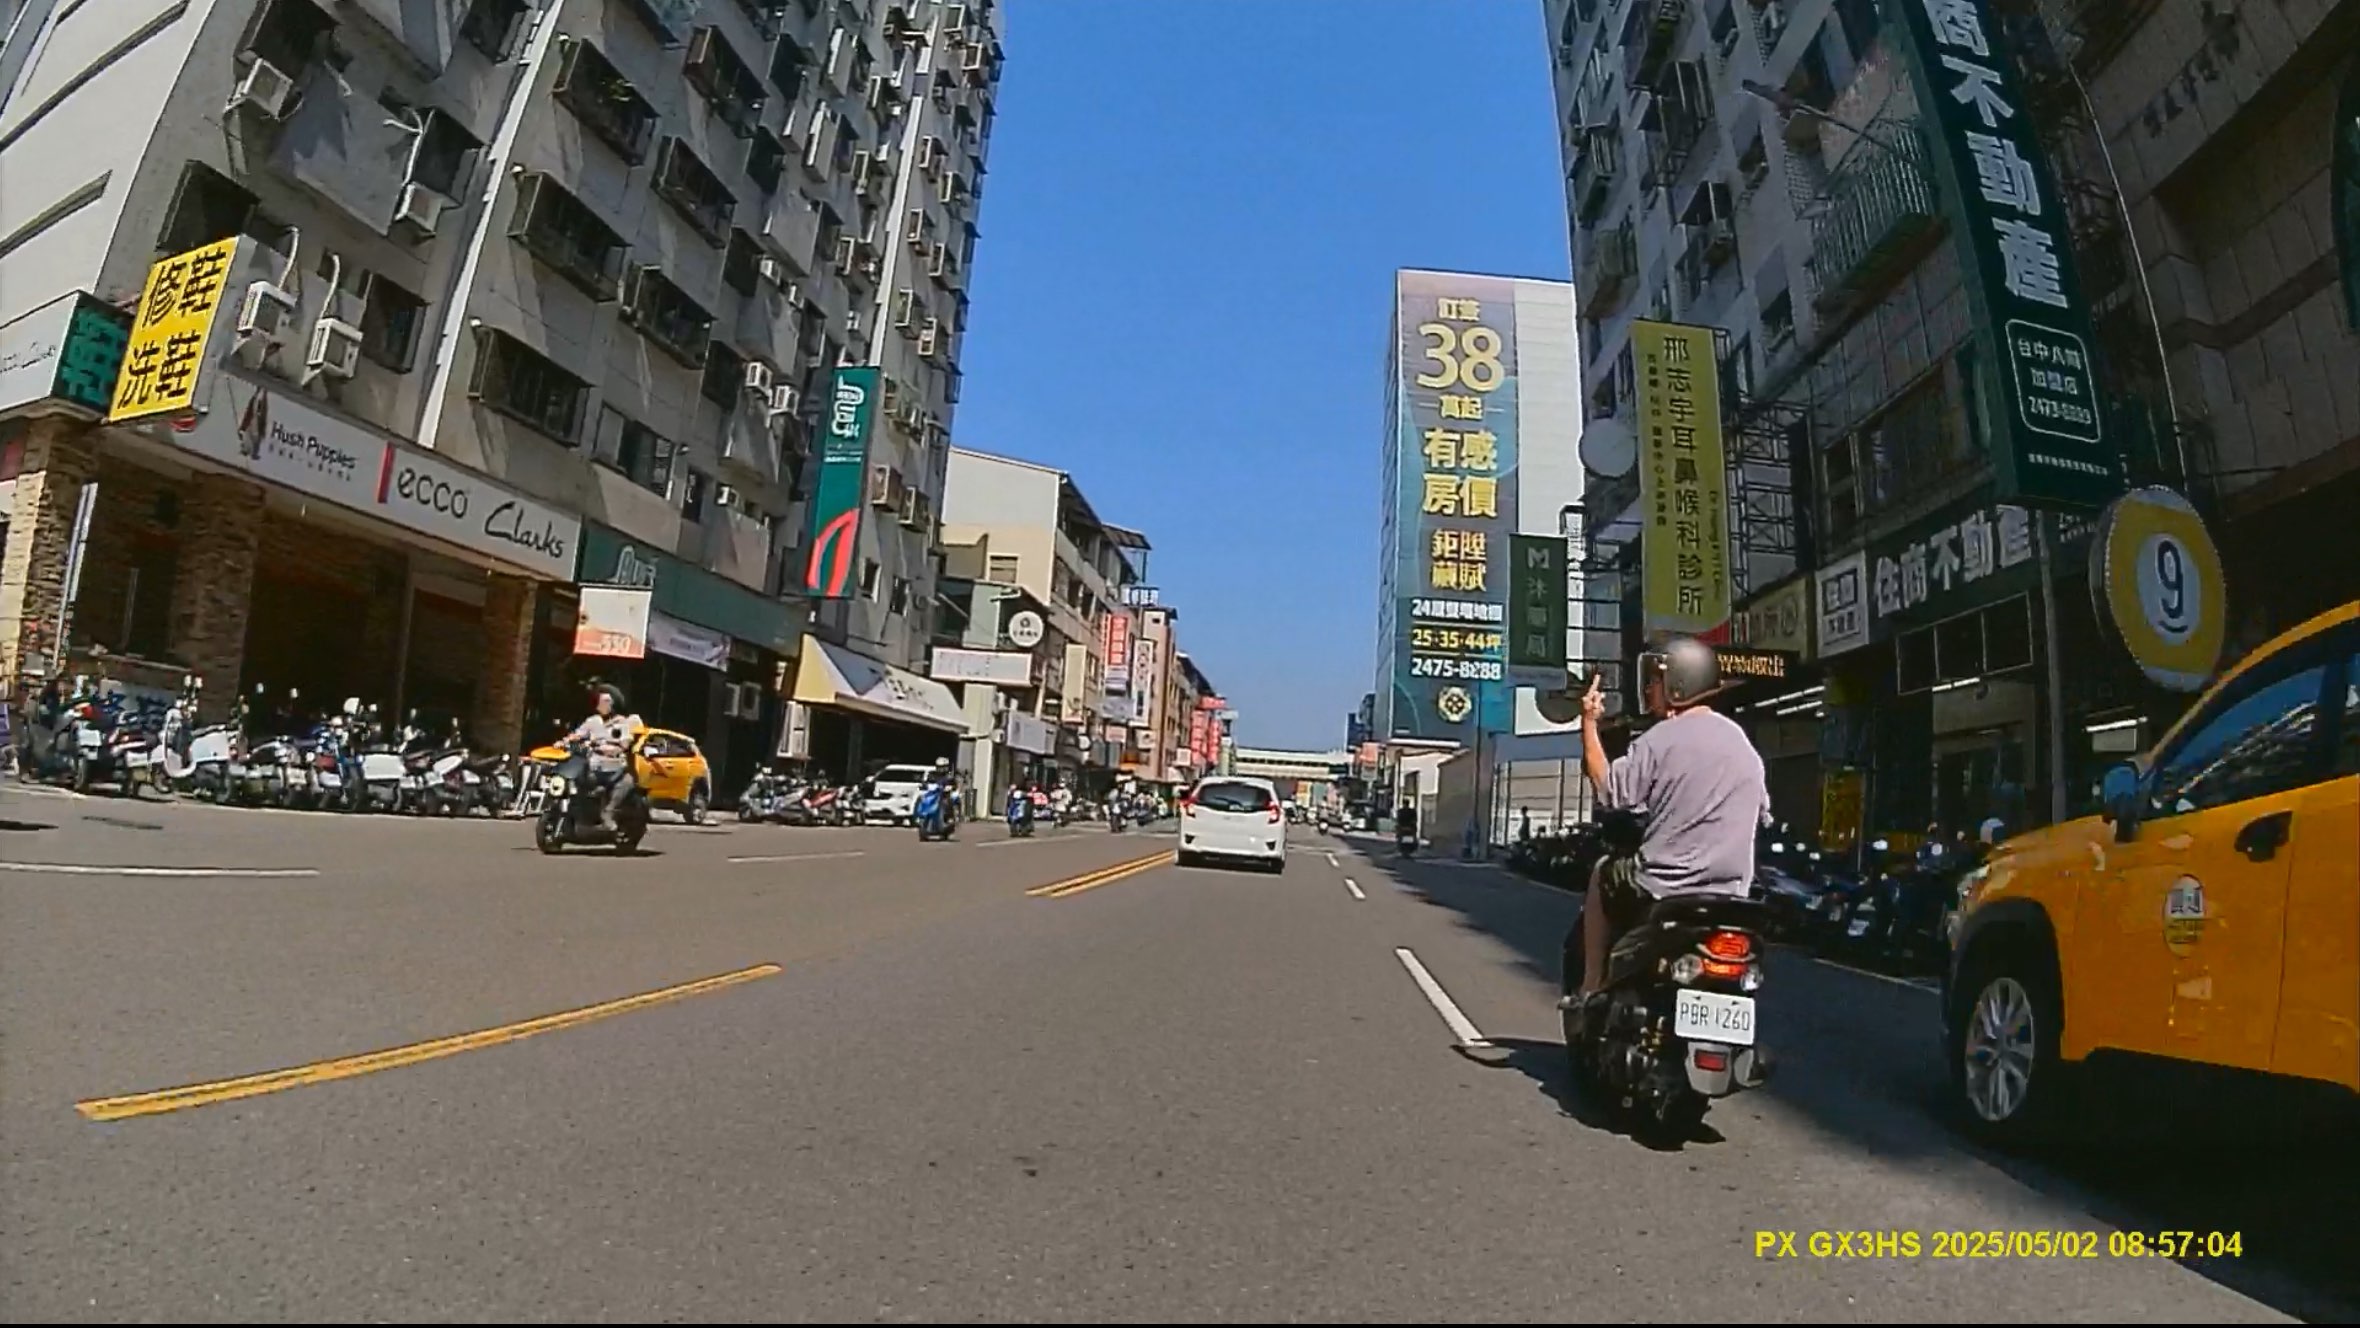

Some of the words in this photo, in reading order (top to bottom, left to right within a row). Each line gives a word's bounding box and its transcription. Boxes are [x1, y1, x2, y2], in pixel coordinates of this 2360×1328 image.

[1923, 0, 2068, 308] 商不動產
[142, 246, 227, 328] 修鞋
[117, 329, 201, 409] 洗鞋
[1416, 323, 1505, 392] 38
[271, 420, 305, 450] Hush
[307, 435, 357, 470] Puppies
[1423, 428, 1498, 470] 有感
[397, 467, 469, 519] ecco
[484, 501, 566, 558] Clarks
[1422, 472, 1498, 517] 房價
[1873, 503, 2033, 619] 住商不動產
[2157, 540, 2184, 619] 9
